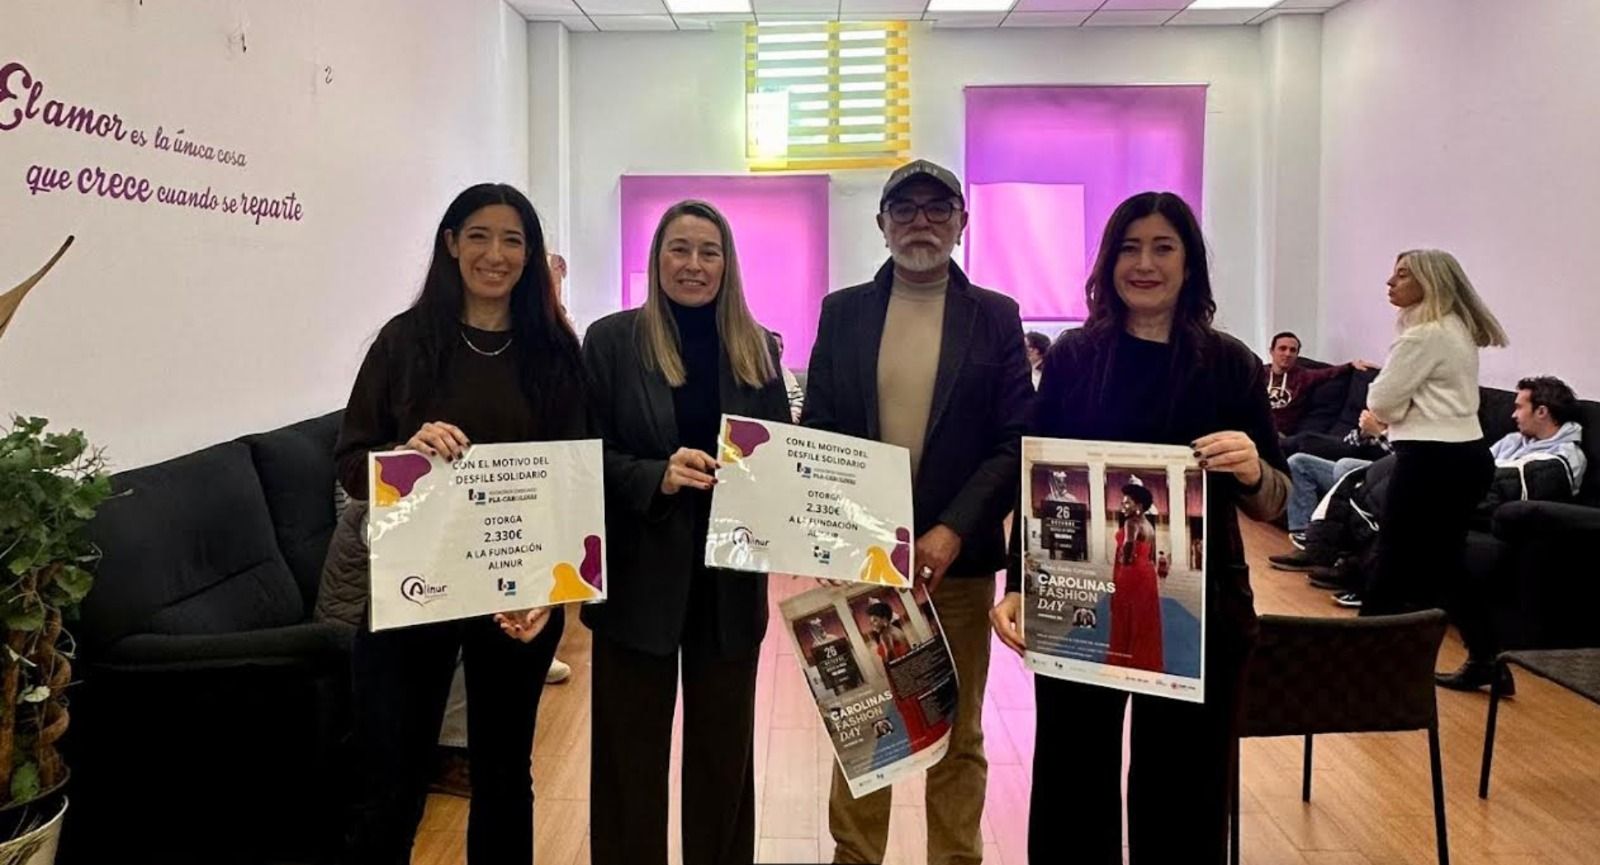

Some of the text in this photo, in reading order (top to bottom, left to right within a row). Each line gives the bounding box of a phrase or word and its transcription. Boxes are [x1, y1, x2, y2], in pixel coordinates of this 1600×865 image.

[0, 62, 247, 167] El amor es la única cosa
[26, 165, 303, 225] que crece cuando se reparte
[785, 437, 868, 458] CON EL MOTIVO DEL
[452, 456, 549, 470] CON EL MOTIVO DEL
[787, 449, 866, 469] DESFILE SOLIDARIO
[455, 470, 548, 485] DESFILE SOLIDARIO
[806, 502, 840, 516] 2.330€
[1056, 505, 1070, 519] 26
[484, 515, 523, 526] OTORGA
[484, 529, 523, 543] 2.330€
[465, 543, 542, 560] A LA FUNDACIÓN
[488, 558, 523, 570] ALINUR
[1037, 573, 1116, 593] CAROLINAS
[1039, 585, 1098, 603] FASHION
[1037, 598, 1065, 612] DAY
[824, 645, 837, 659] 26
[830, 690, 893, 721] CAROLINAS
[836, 706, 883, 732] FASHION
[840, 727, 862, 743] DAY
